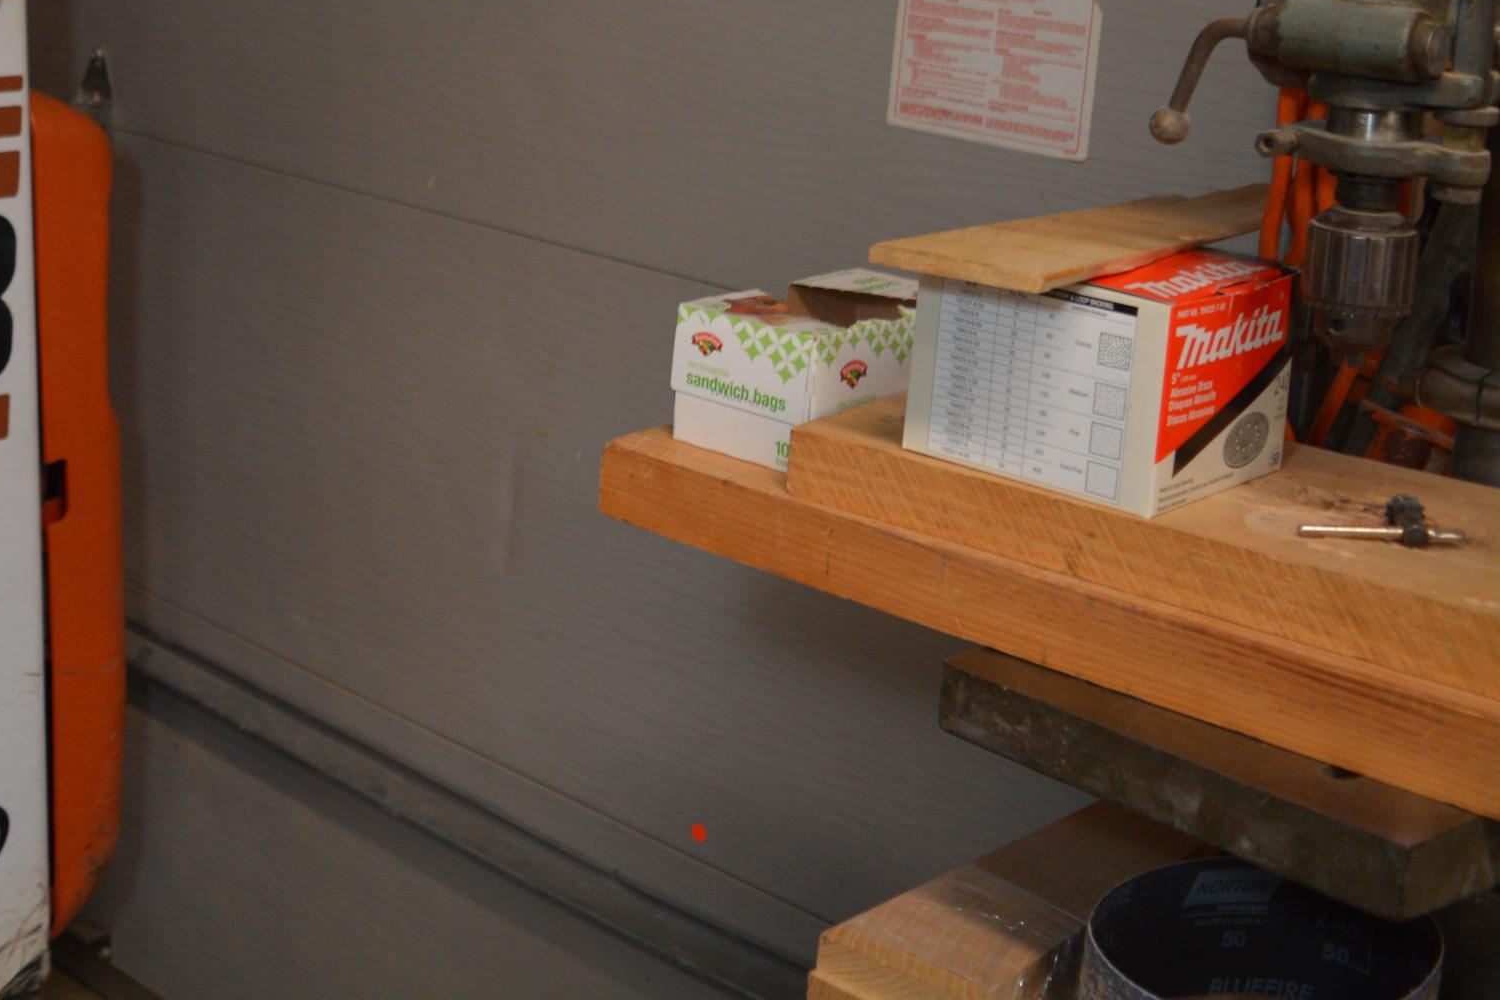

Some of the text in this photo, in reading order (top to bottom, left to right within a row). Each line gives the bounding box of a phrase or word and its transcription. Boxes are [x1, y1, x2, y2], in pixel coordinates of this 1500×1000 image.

[1123, 262, 1268, 299] Makita
[1176, 305, 1283, 370] Makita
[686, 371, 786, 412] sandwich bags
[1198, 878, 1270, 895] NORTON
[1220, 931, 1247, 949] 50
[1321, 942, 1350, 965] 50
[1209, 977, 1316, 999] BLUEFIRE
